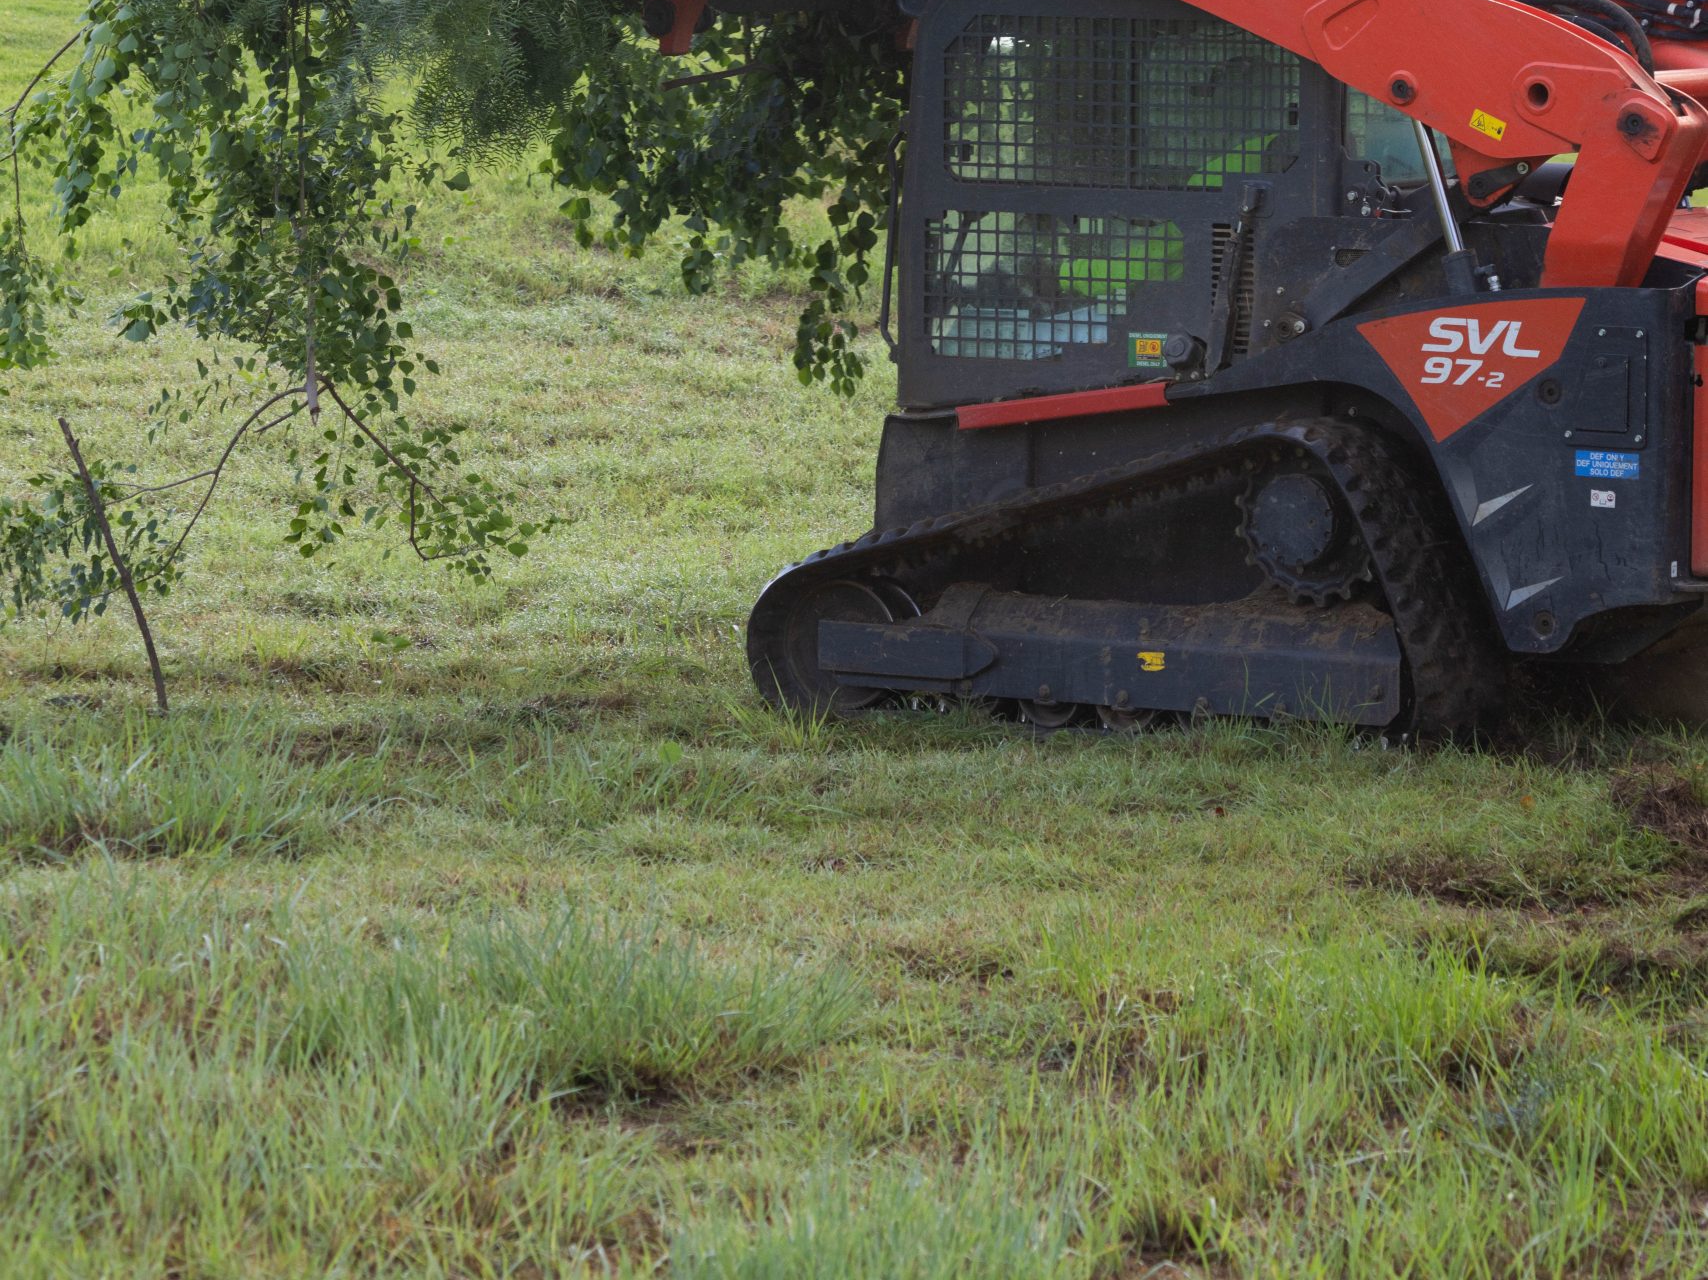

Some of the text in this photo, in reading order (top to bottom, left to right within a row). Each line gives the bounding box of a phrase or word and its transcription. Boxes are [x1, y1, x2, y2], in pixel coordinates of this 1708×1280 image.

[1421, 316, 1540, 358] SVL
[1420, 356, 1505, 388] 97-2
[1590, 452, 1604, 460] DEF
[1576, 459, 1638, 470] DEF UNIQUEMENT
[1590, 468, 1624, 477] SOLO DEF
